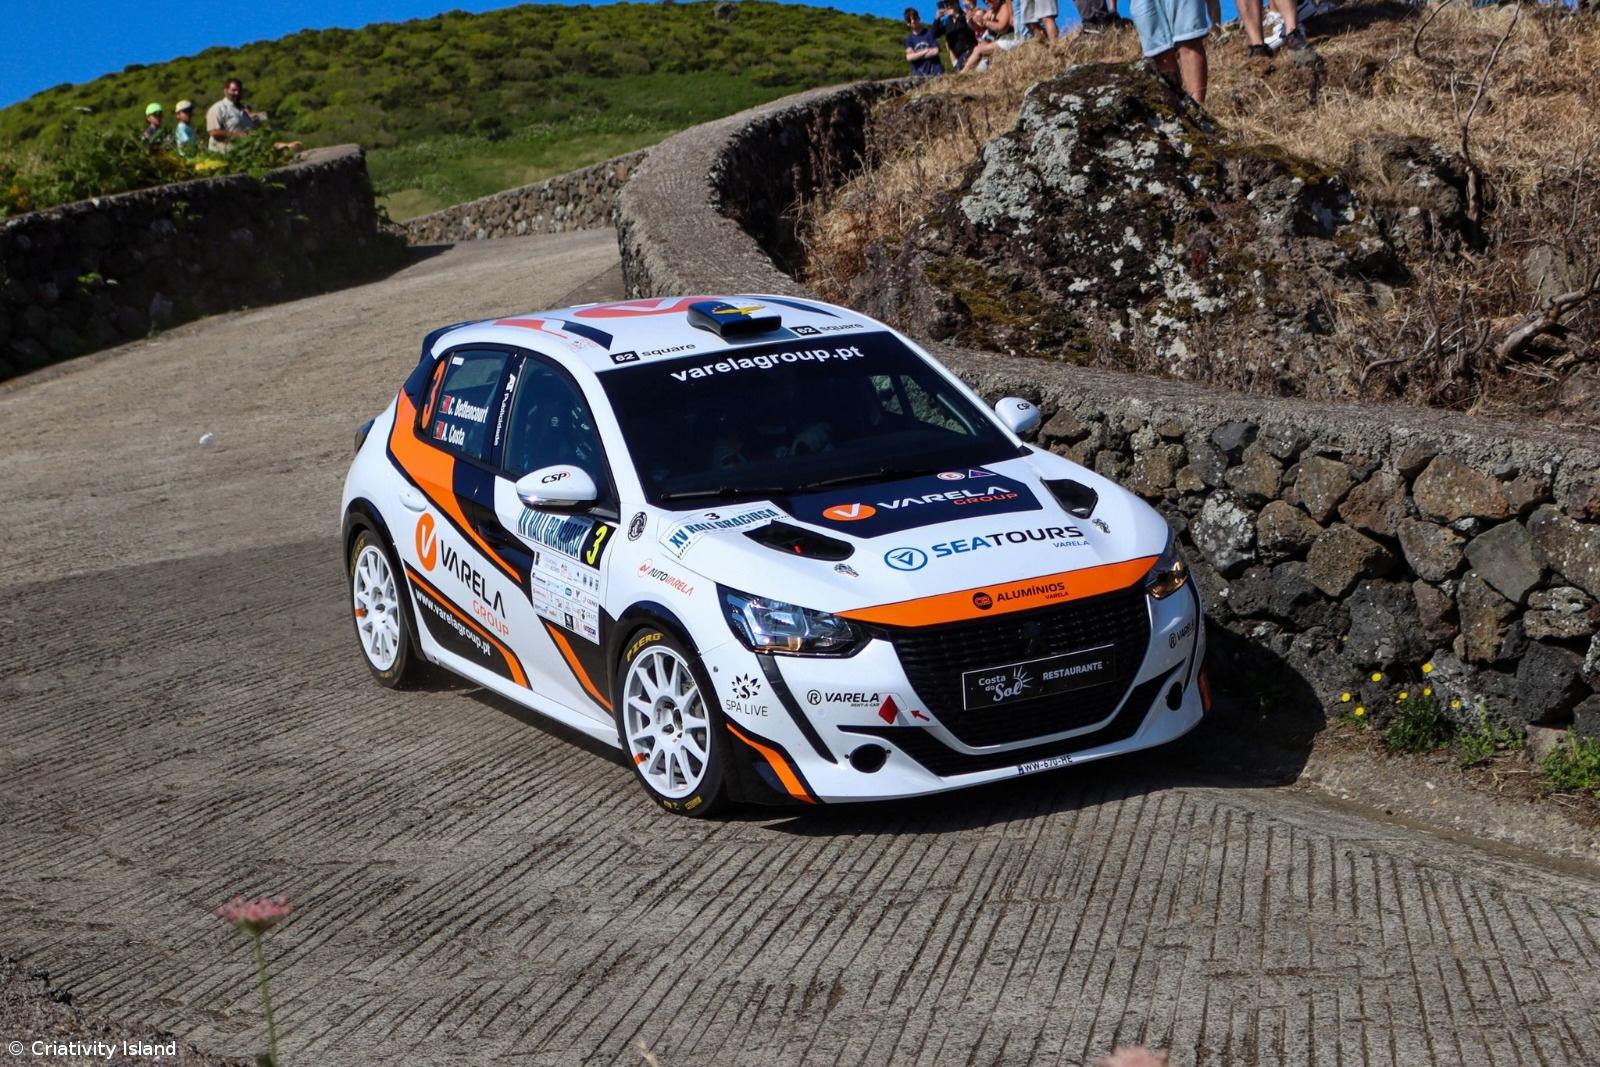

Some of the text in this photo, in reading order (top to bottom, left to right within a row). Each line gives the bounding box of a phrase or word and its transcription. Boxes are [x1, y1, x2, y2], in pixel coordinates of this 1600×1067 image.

[797, 323, 864, 335] 62 square
[614, 342, 696, 363] 62 square
[670, 345, 864, 383] varelagroup.pt
[422, 360, 445, 430] 3
[447, 397, 489, 424] C. Bettencourt
[441, 423, 465, 446] A. Costa
[541, 472, 567, 484] CSP
[877, 486, 1011, 510] VARELA
[953, 492, 1018, 506] GROUP
[704, 512, 721, 521] 3
[528, 510, 548, 543] RALI
[544, 516, 588, 558] GRACIOSA
[670, 508, 779, 550] XV RALI GRACIOSA
[586, 525, 608, 565] 3
[931, 525, 1084, 558] SEATOURS
[1052, 539, 1090, 549] VARELA
[441, 540, 506, 619] VARELA
[648, 567, 694, 597] AUTOVARELA
[997, 582, 1065, 602] ALUMÍNIOS
[1045, 591, 1069, 600] VARELA
[415, 588, 491, 657] www.varelagroup.pt
[472, 600, 509, 637] GROUP
[978, 675, 1006, 686] Costa
[1042, 661, 1103, 680] RESTAURANTE
[824, 692, 880, 703] VARELA
[993, 679, 1023, 701] Sol
[726, 699, 768, 717] SPA LIVE
